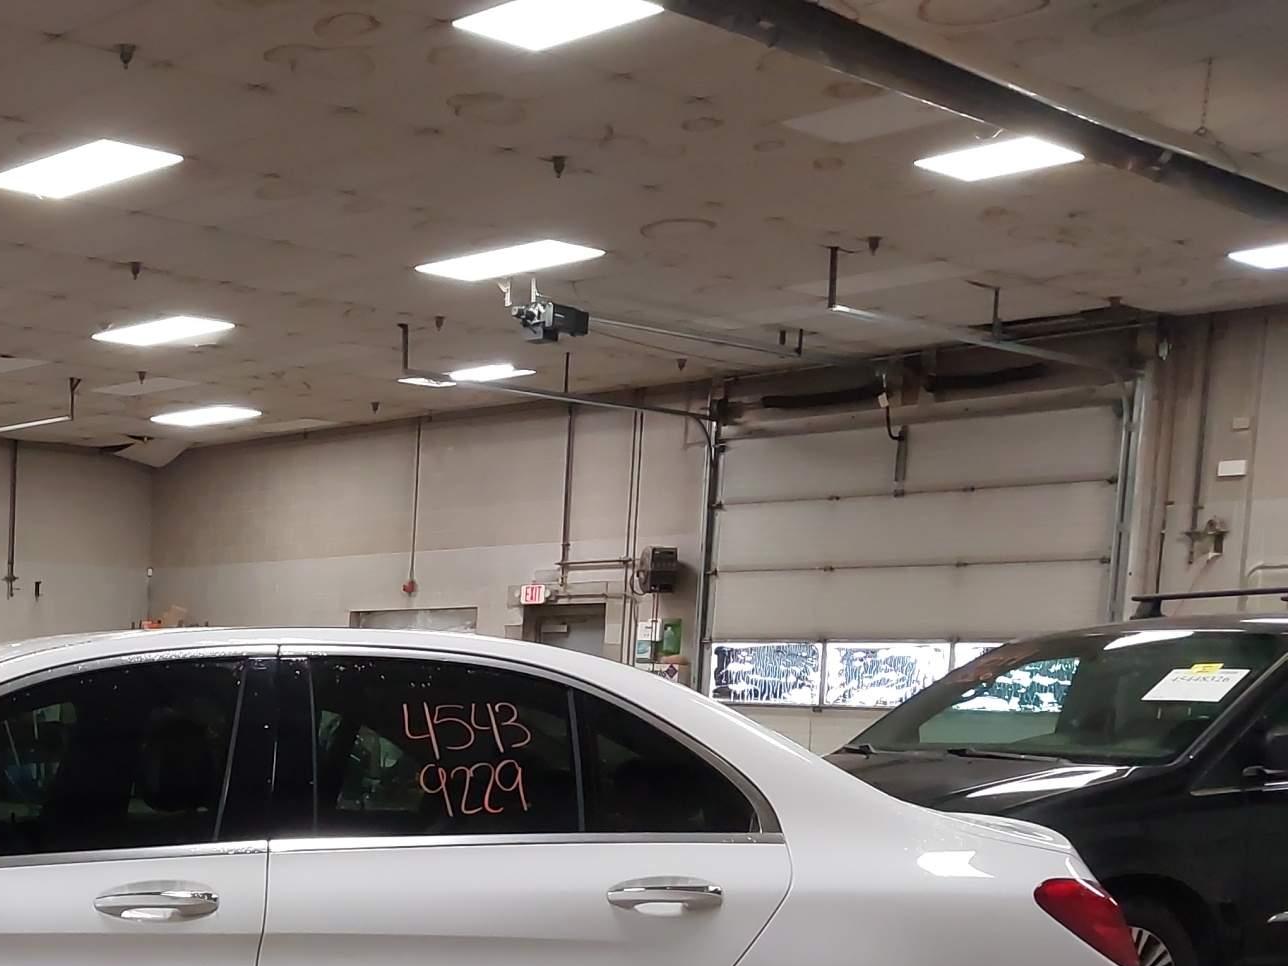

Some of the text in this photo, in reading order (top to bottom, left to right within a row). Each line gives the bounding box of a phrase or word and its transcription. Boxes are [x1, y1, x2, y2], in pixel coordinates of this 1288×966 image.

[525, 586, 542, 602] EXIT
[402, 701, 531, 760] 4543
[419, 759, 528, 817] 9229
